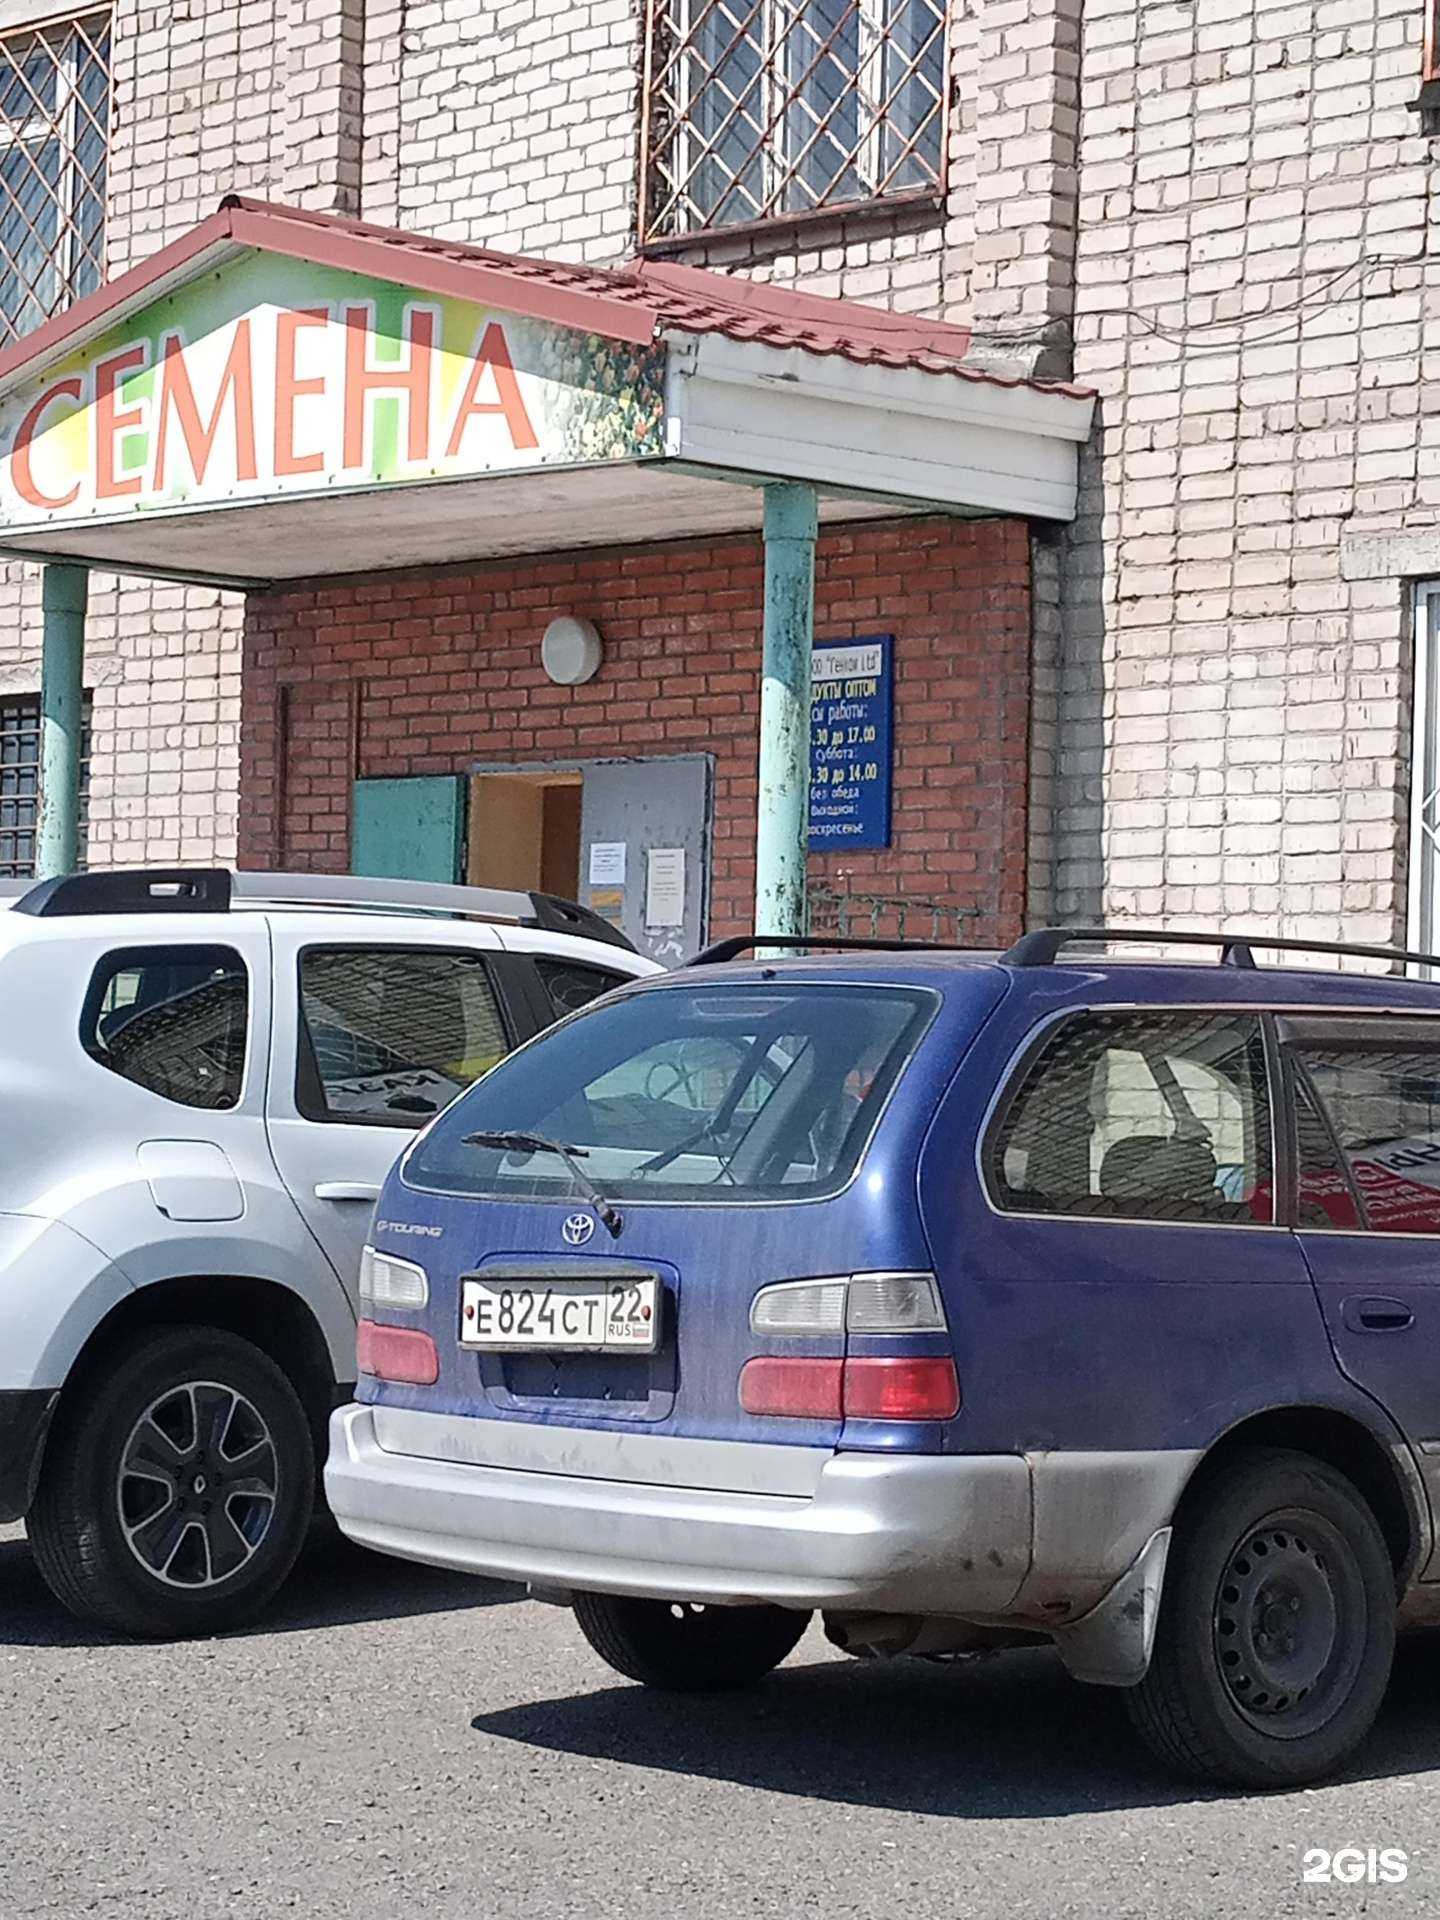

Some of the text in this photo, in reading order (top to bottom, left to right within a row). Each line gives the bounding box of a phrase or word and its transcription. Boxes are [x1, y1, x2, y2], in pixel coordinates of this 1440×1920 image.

[10, 306, 540, 510] СЕМЕНА
[828, 700, 868, 726] работы:
[831, 730, 844, 747] до
[847, 725, 876, 743] 17.00
[832, 768, 845, 785] до
[849, 763, 877, 782] 14.00
[831, 785, 860, 800] обеда
[476, 1285, 642, 1336] Е824СТ 22
[608, 1323, 632, 1337] RUS
